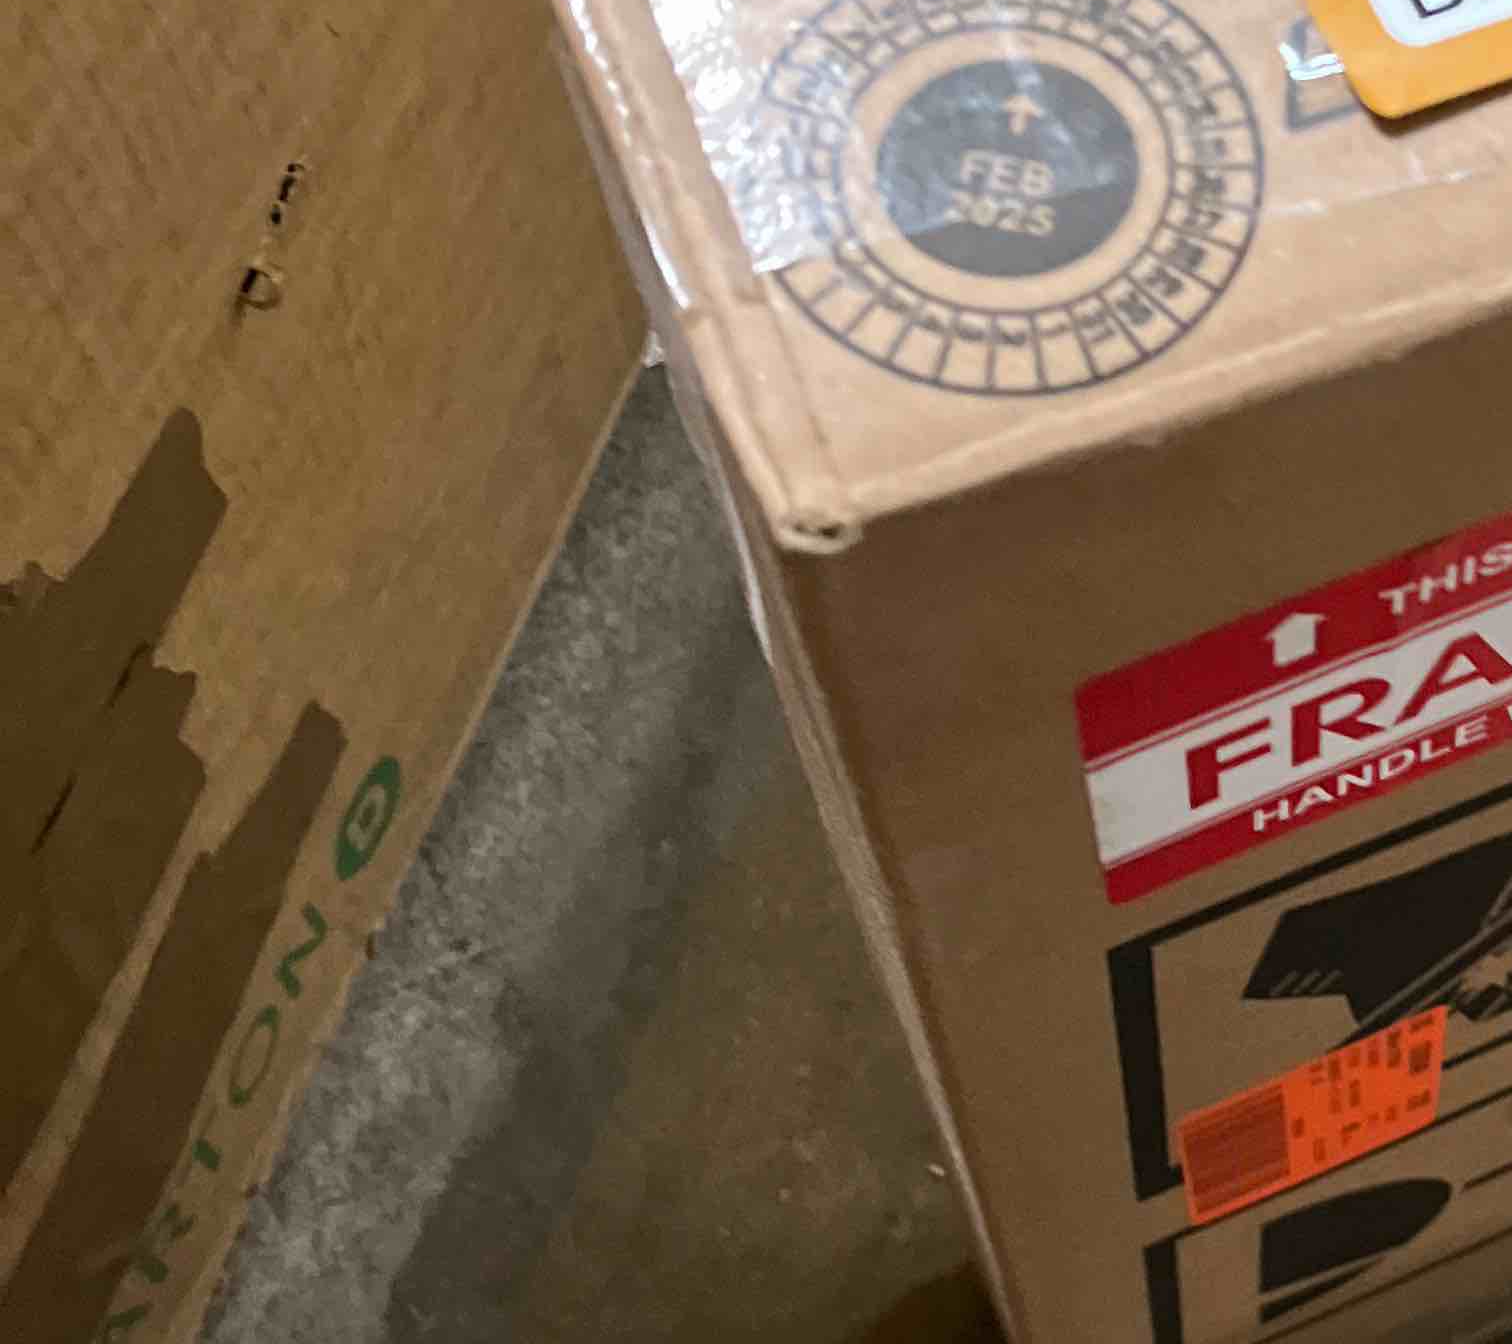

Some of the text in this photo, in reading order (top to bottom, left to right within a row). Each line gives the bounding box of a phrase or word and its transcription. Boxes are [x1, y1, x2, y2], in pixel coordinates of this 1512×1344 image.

[958, 148, 1056, 197] FEB
[944, 189, 1056, 237] 2025
[1250, 712, 1492, 835] HANDLE
